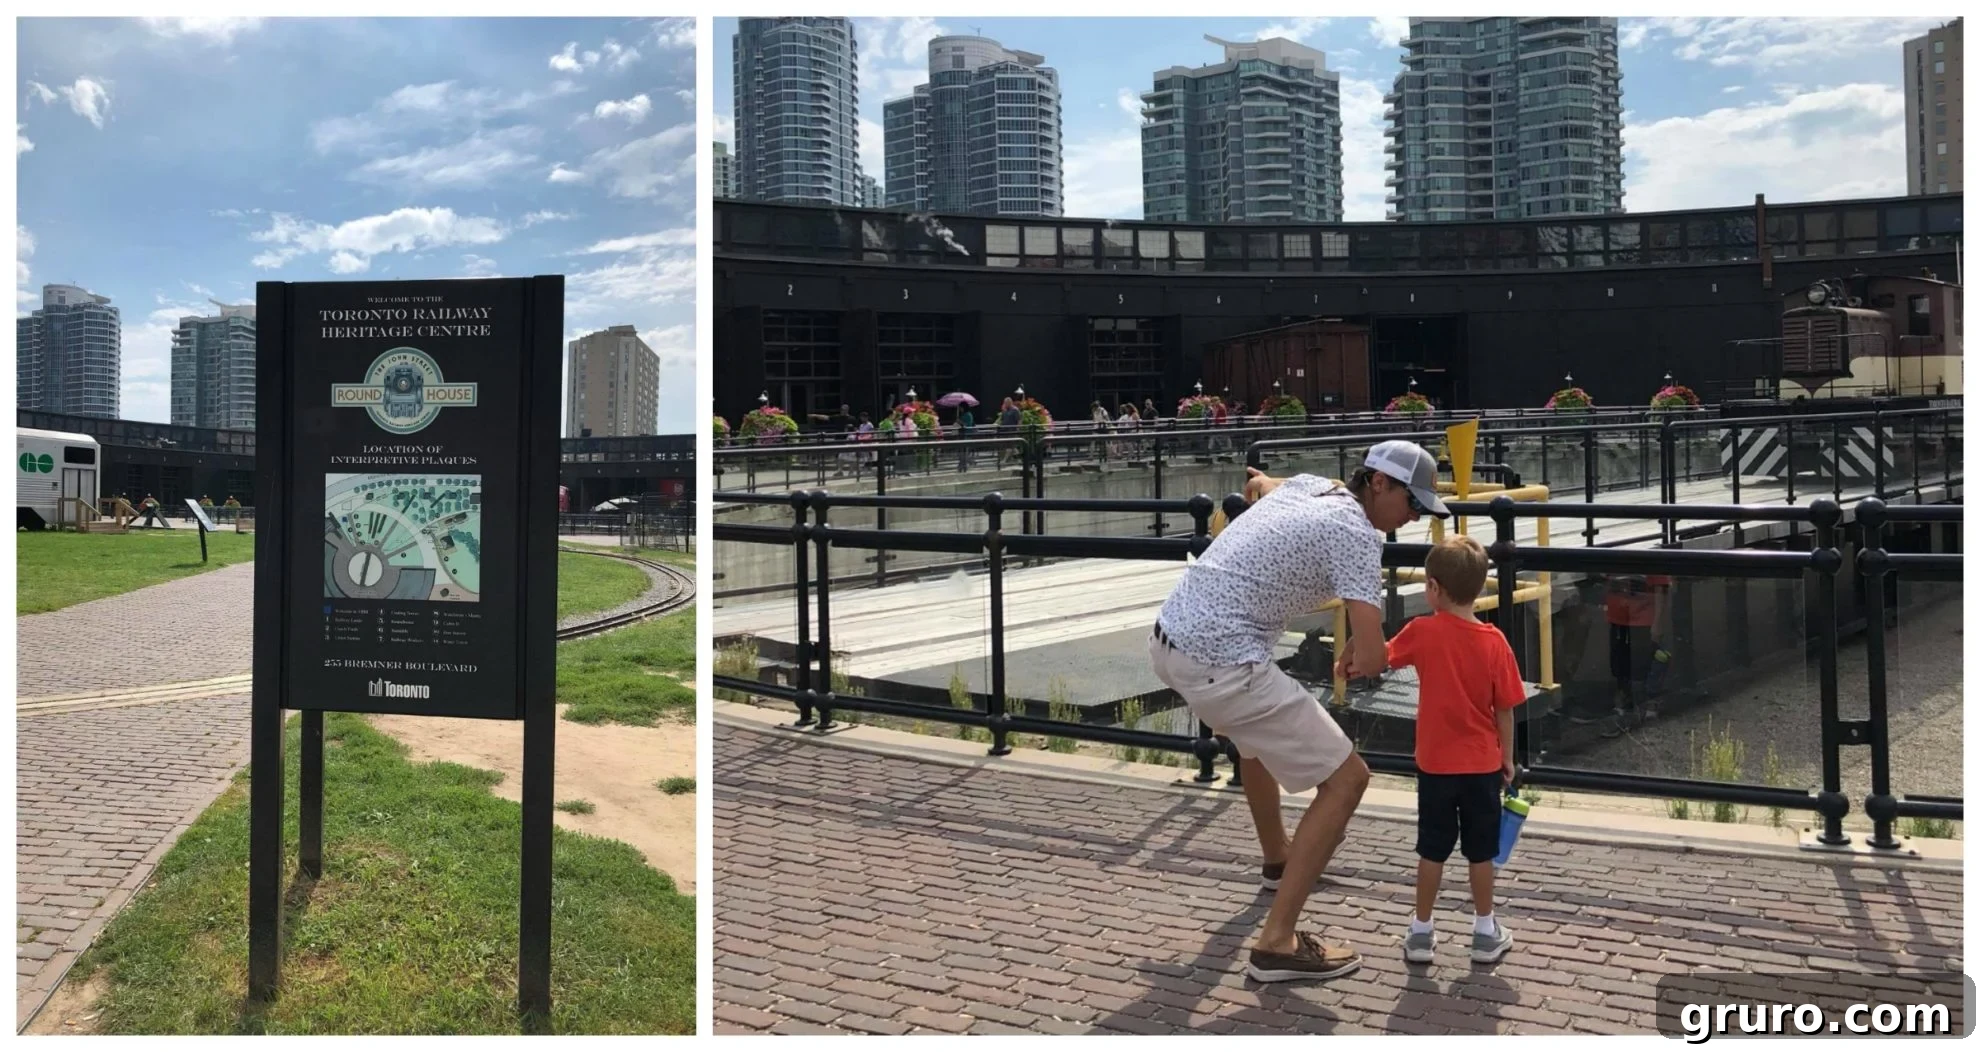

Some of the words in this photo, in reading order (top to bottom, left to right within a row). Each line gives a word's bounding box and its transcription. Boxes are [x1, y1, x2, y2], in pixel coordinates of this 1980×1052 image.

[787, 284, 793, 296] 2
[903, 288, 909, 300] 3
[1011, 292, 1017, 302] 4
[1119, 294, 1124, 304] 5
[319, 308, 408, 321] TORONTO
[413, 307, 492, 320] RAILWAY
[321, 326, 413, 338] HERITAGE
[417, 325, 491, 337] CENTRE
[374, 364, 386, 376] THE
[388, 355, 408, 365] JOHN
[411, 355, 433, 376] STREET
[337, 389, 382, 401] ROUND
[427, 389, 472, 400] HOUSE
[363, 445, 424, 454] LOCATION
[426, 445, 444, 454] OF
[18, 452, 55, 474] GO
[331, 455, 419, 465] INTERPRETIVE
[421, 456, 477, 465] PLAQUES
[324, 659, 342, 668] 255
[344, 660, 402, 670] BREMNER
[405, 661, 478, 673] BOULEVARD
[384, 680, 430, 699] TORONTO
